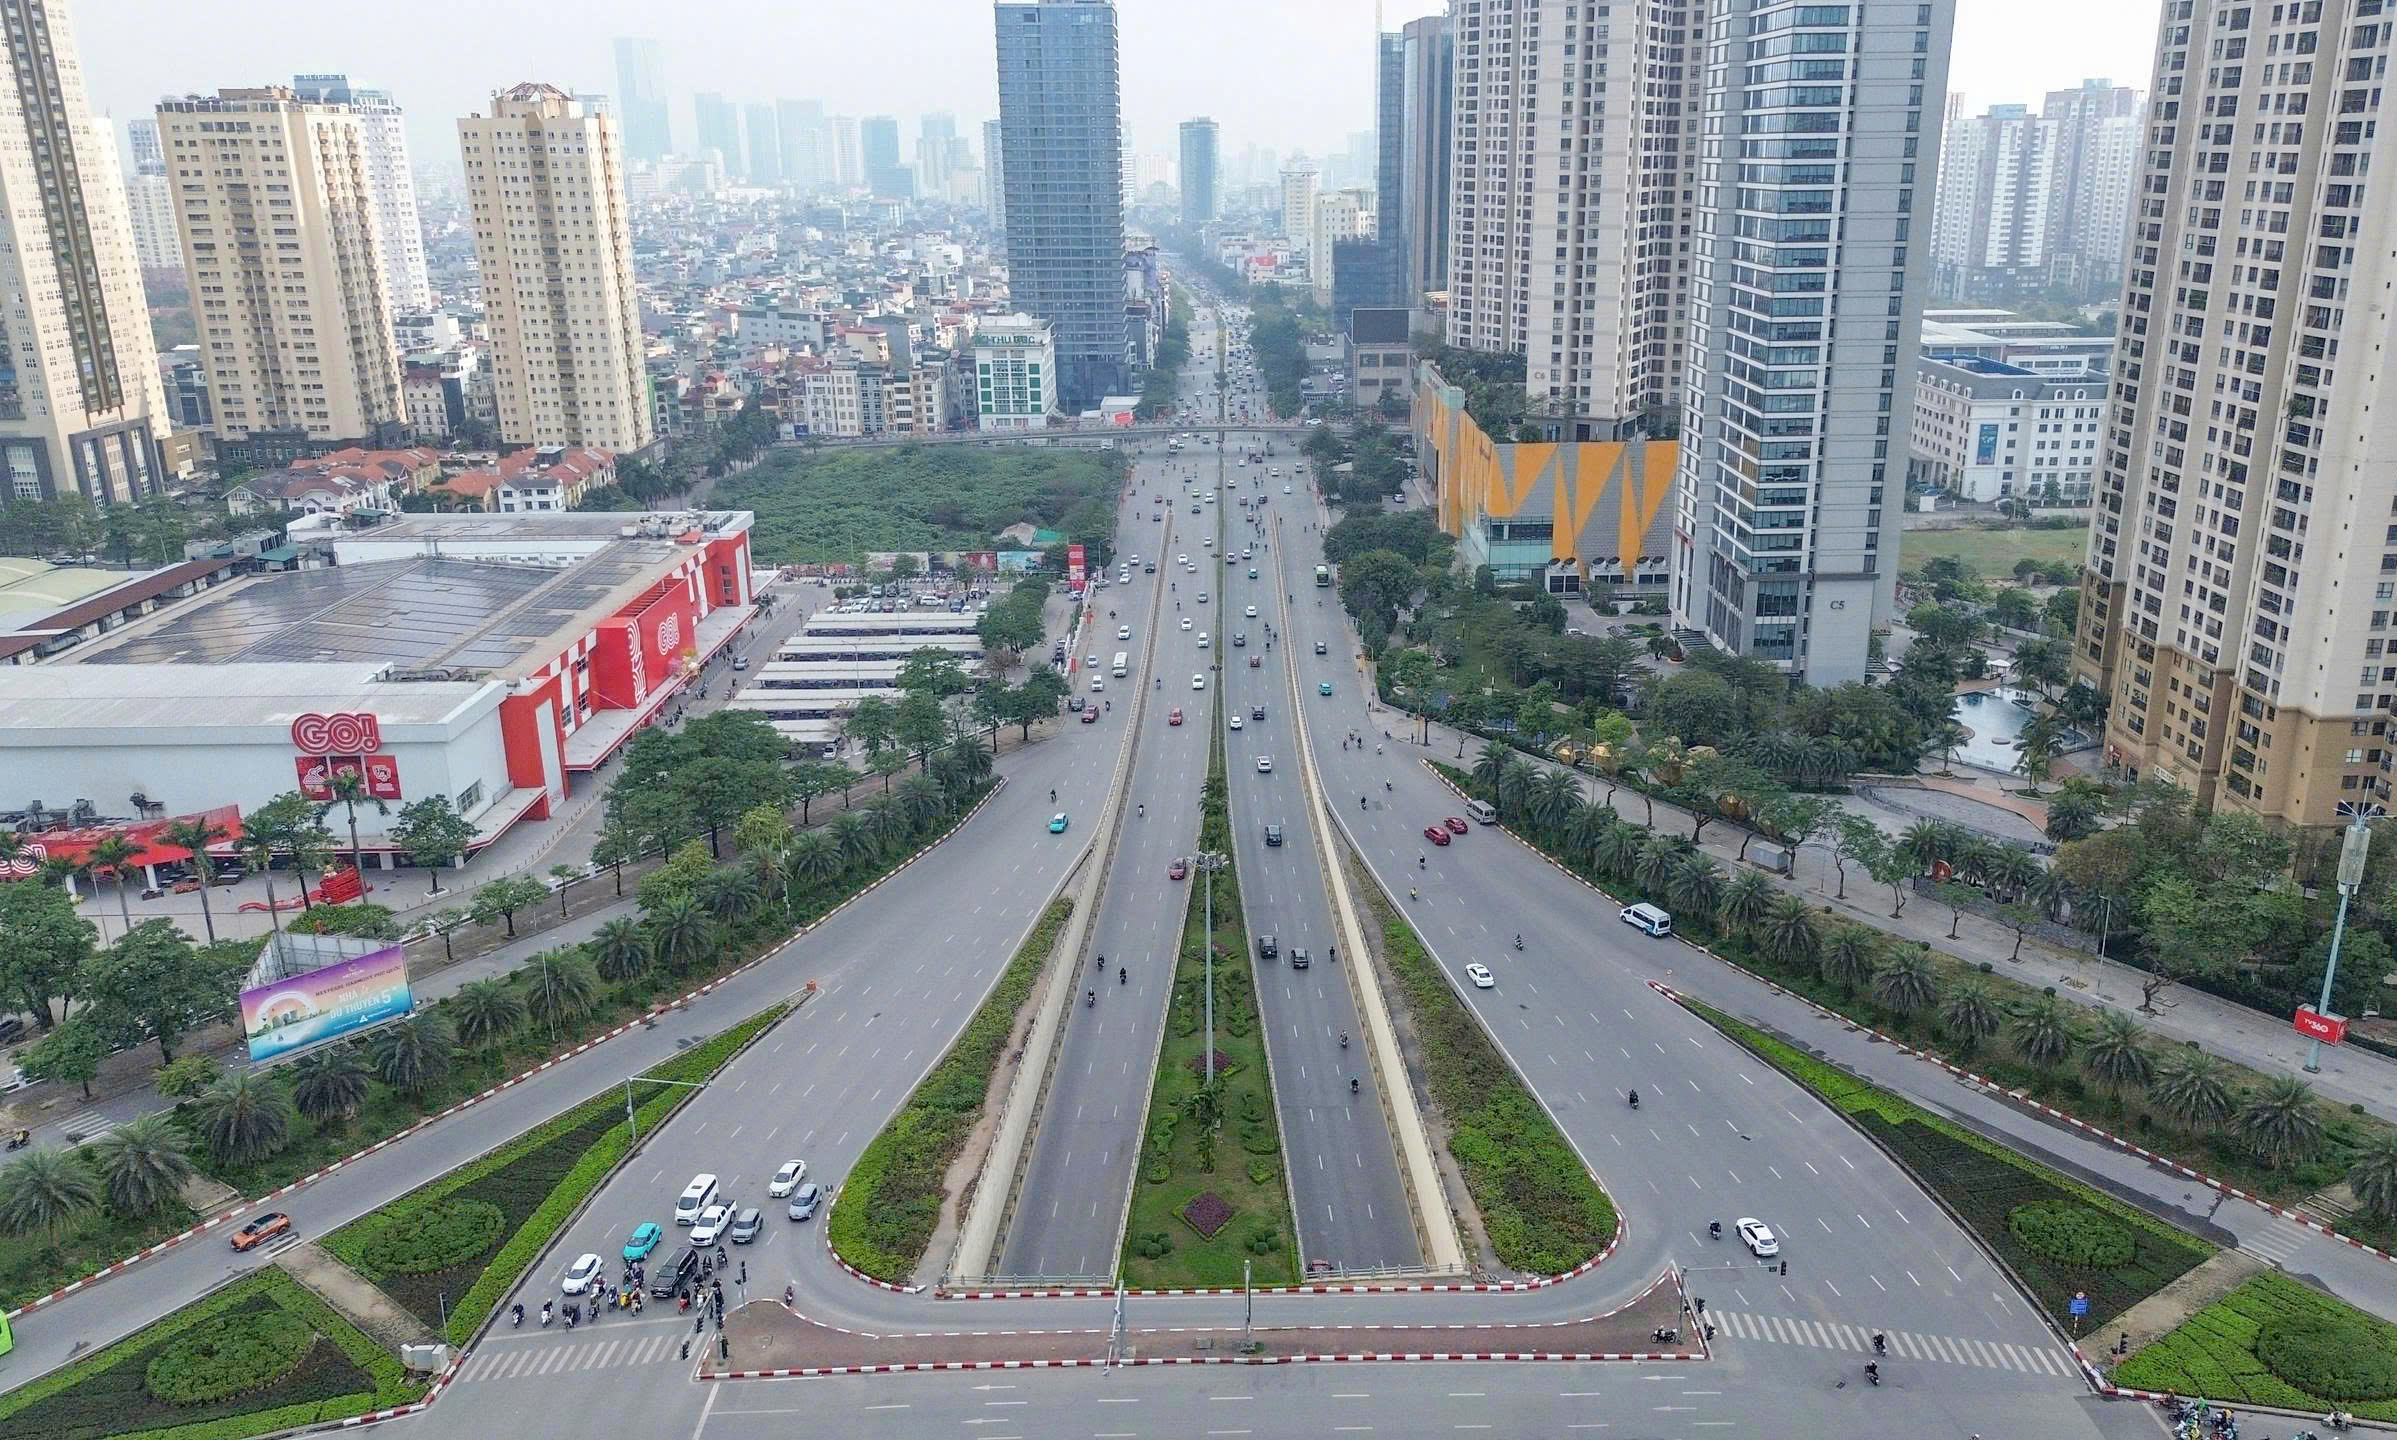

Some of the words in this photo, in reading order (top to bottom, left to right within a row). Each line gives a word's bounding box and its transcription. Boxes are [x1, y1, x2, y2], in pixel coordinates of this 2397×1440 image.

[1830, 600, 1846, 610] C5
[658, 612, 680, 655] GO!
[292, 713, 379, 754] GO!
[2304, 1017, 2329, 1033] TV360
